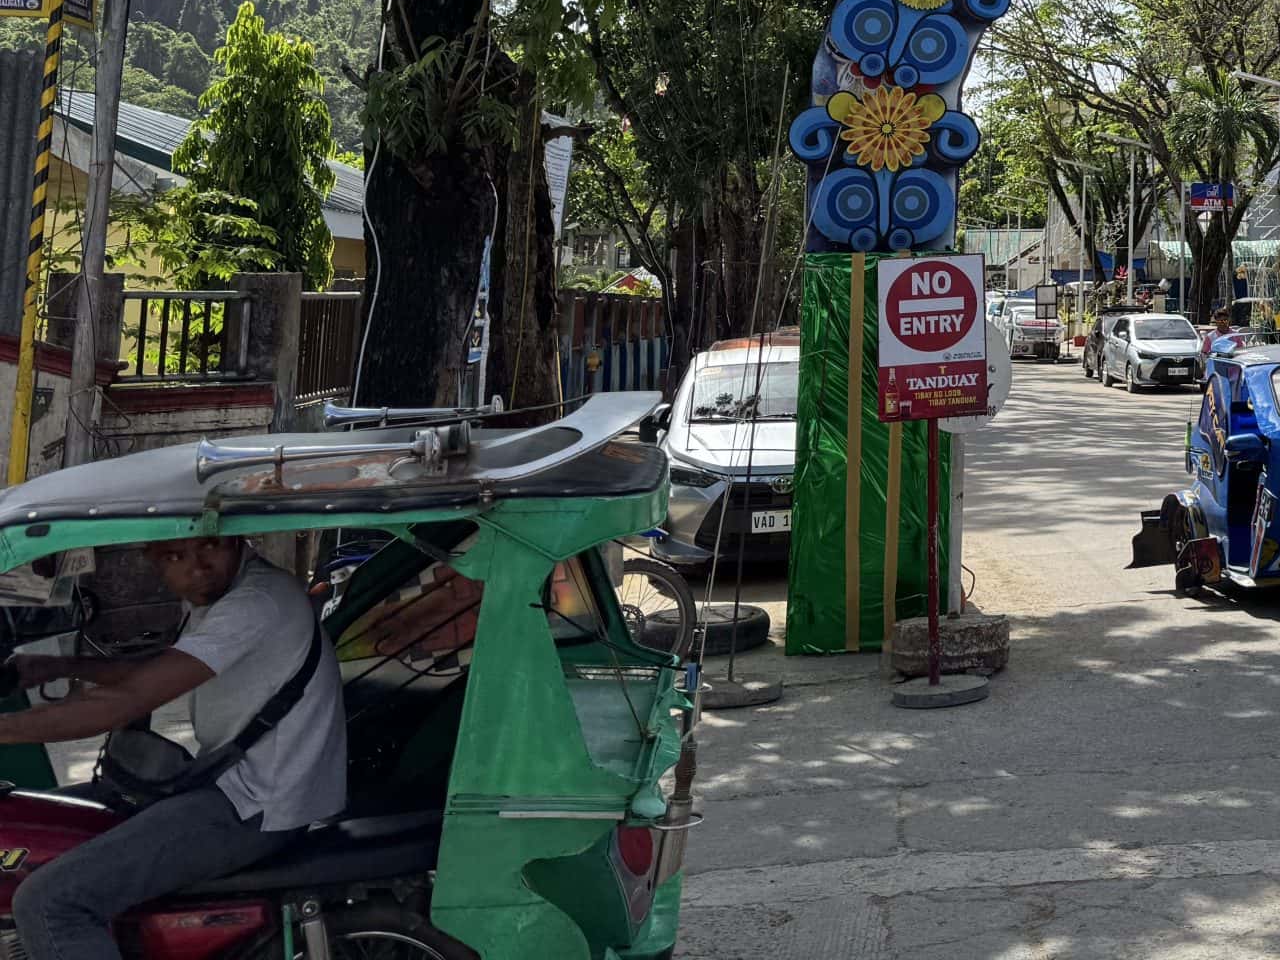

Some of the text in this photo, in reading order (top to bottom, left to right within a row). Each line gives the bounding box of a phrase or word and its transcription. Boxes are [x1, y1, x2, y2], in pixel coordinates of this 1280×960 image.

[1203, 198, 1222, 207] ATM
[911, 270, 952, 296] NO
[899, 313, 964, 336] ENTRY
[906, 373, 979, 390] TANDUAY
[754, 515, 776, 529] VAD
